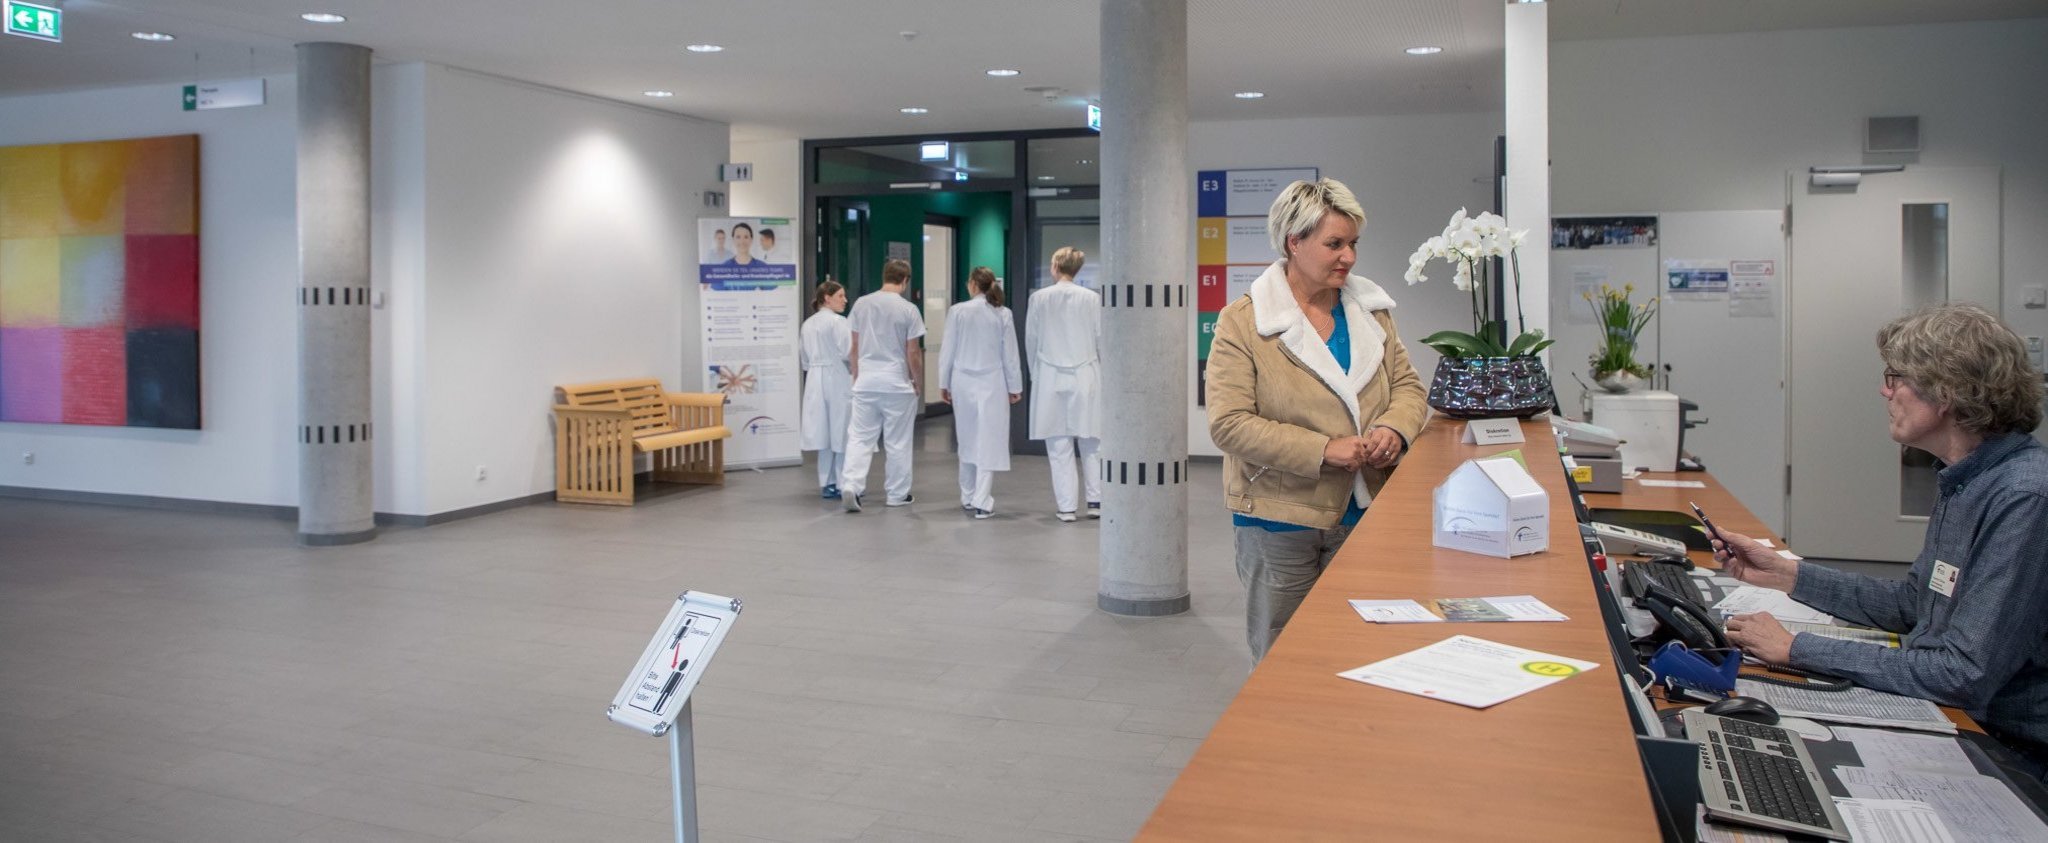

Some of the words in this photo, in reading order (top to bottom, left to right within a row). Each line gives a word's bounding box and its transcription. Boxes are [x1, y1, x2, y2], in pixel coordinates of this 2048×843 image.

[1202, 180, 1219, 191] E3
[1202, 227, 1219, 239] E2
[1202, 275, 1217, 286] E1
